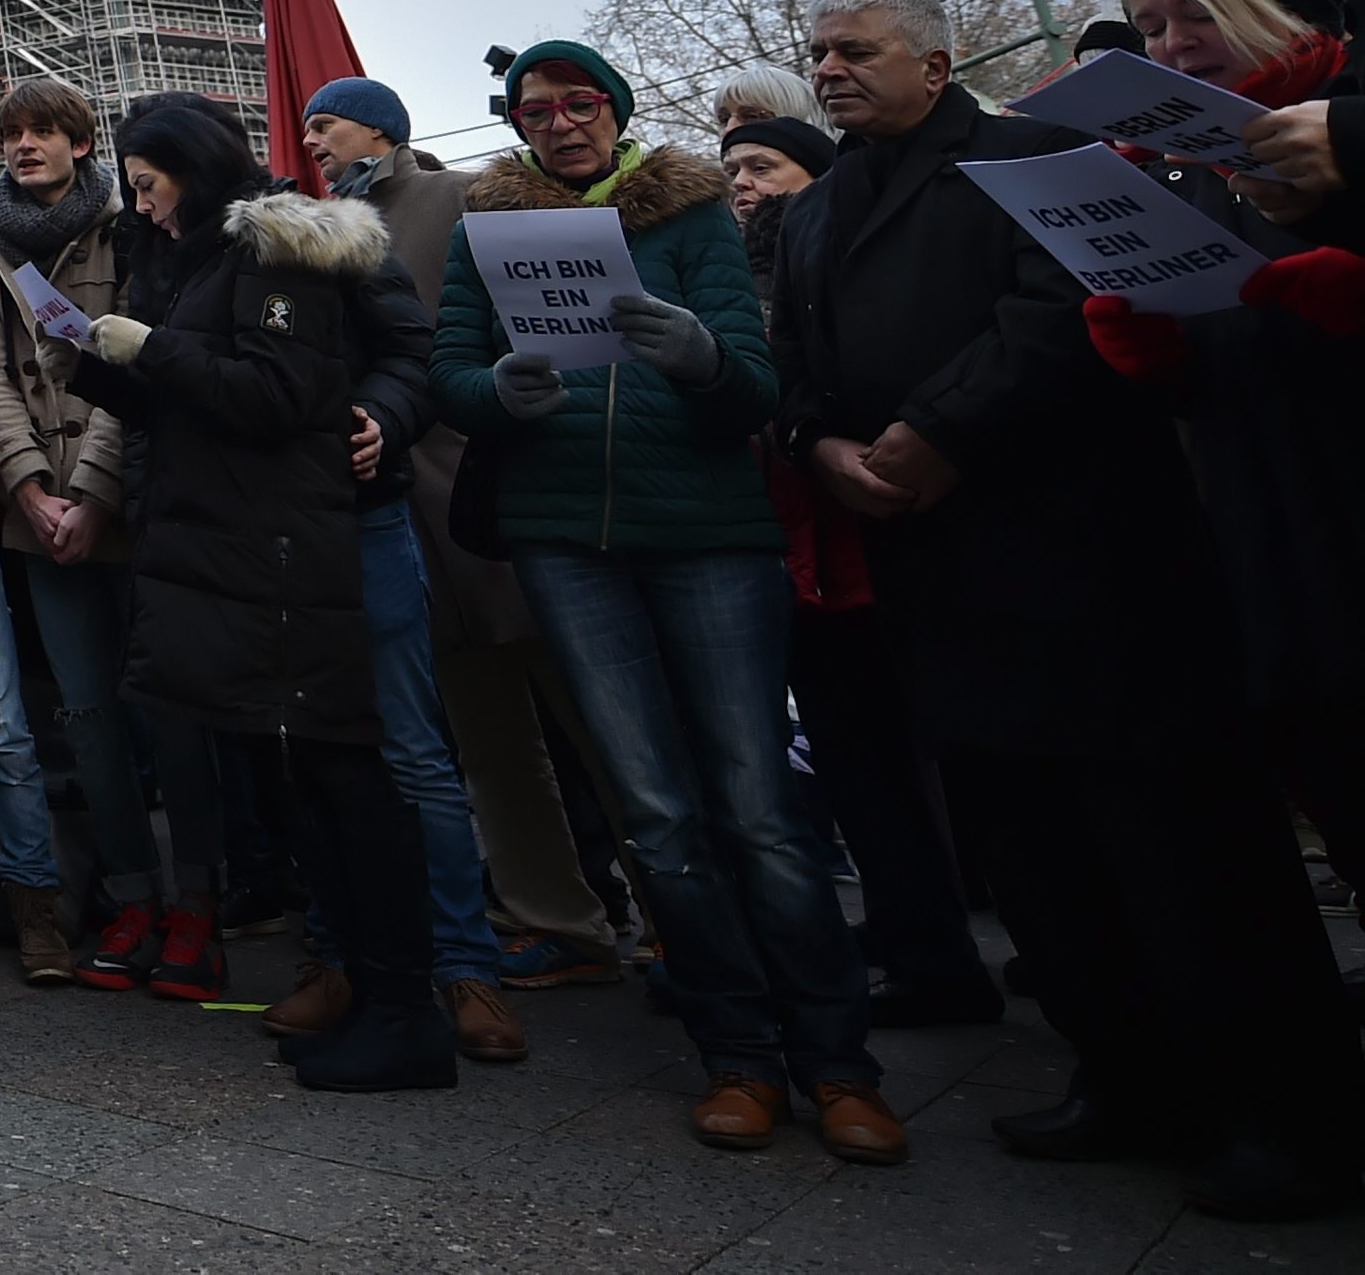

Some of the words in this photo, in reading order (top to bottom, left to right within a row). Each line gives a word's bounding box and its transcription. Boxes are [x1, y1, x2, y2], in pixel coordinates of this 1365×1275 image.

[1101, 96, 1204, 138] BERLIN
[1165, 126, 1242, 154] HÄLT
[1028, 207, 1086, 229] ICH
[1079, 194, 1146, 223] BIN
[1085, 231, 1151, 257] EIN
[503, 260, 552, 280] ICH
[555, 259, 607, 279] BIN
[1078, 242, 1239, 292] BERLINER
[541, 288, 590, 307] EIN
[510, 315, 624, 335] BERLIN
